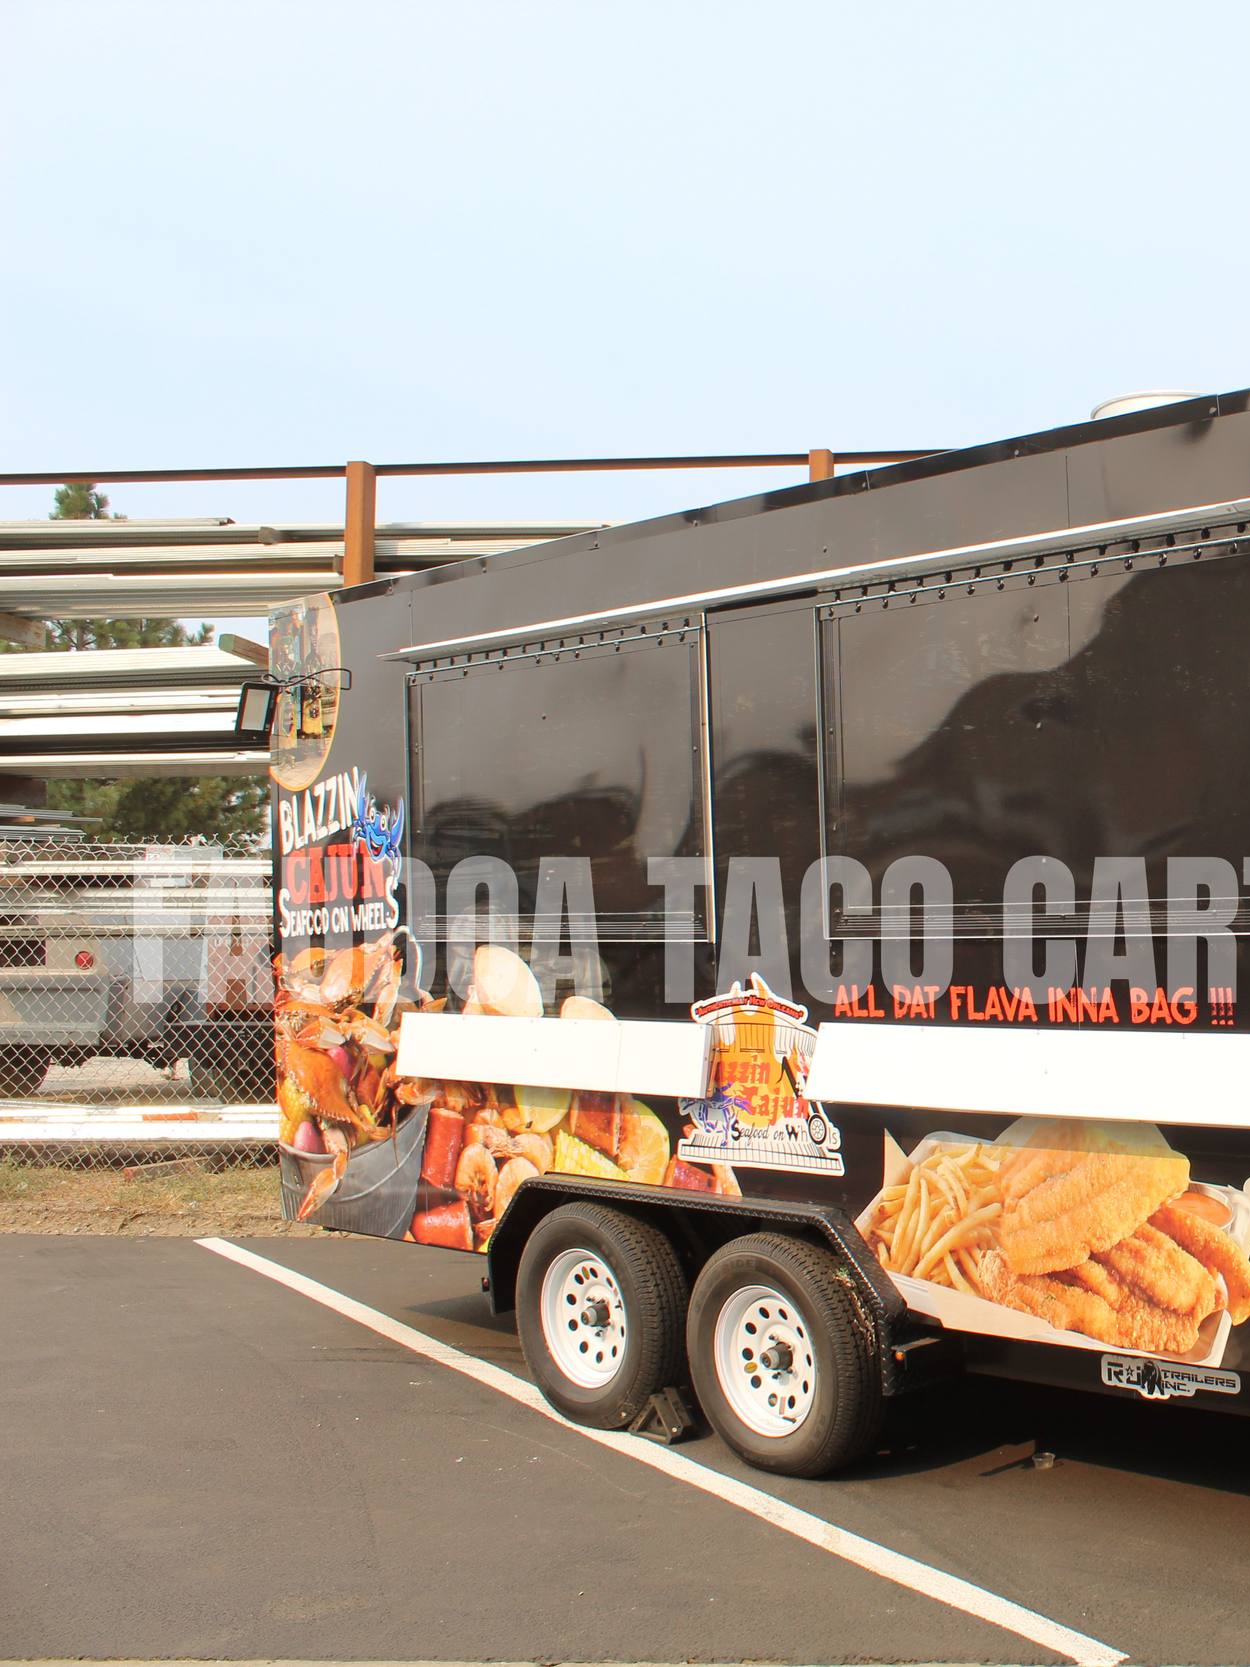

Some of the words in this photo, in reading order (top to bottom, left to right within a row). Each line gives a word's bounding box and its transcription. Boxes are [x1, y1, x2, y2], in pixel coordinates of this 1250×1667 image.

[279, 766, 360, 855] BLAZZIN
[286, 843, 385, 905] CAJUN
[331, 906, 350, 934] ON
[351, 875, 400, 932] WHEELS
[834, 984, 885, 1018] ALL
[893, 985, 940, 1019] DAT
[950, 985, 1036, 1022] FLAVA
[1048, 986, 1120, 1023] INNA
[1129, 986, 1199, 1025] BAG
[1209, 987, 1235, 1026] !!!
[731, 1118, 770, 1146] Seafood
[773, 1130, 785, 1141] on
[1160, 1368, 1237, 1390] TRAILERS
